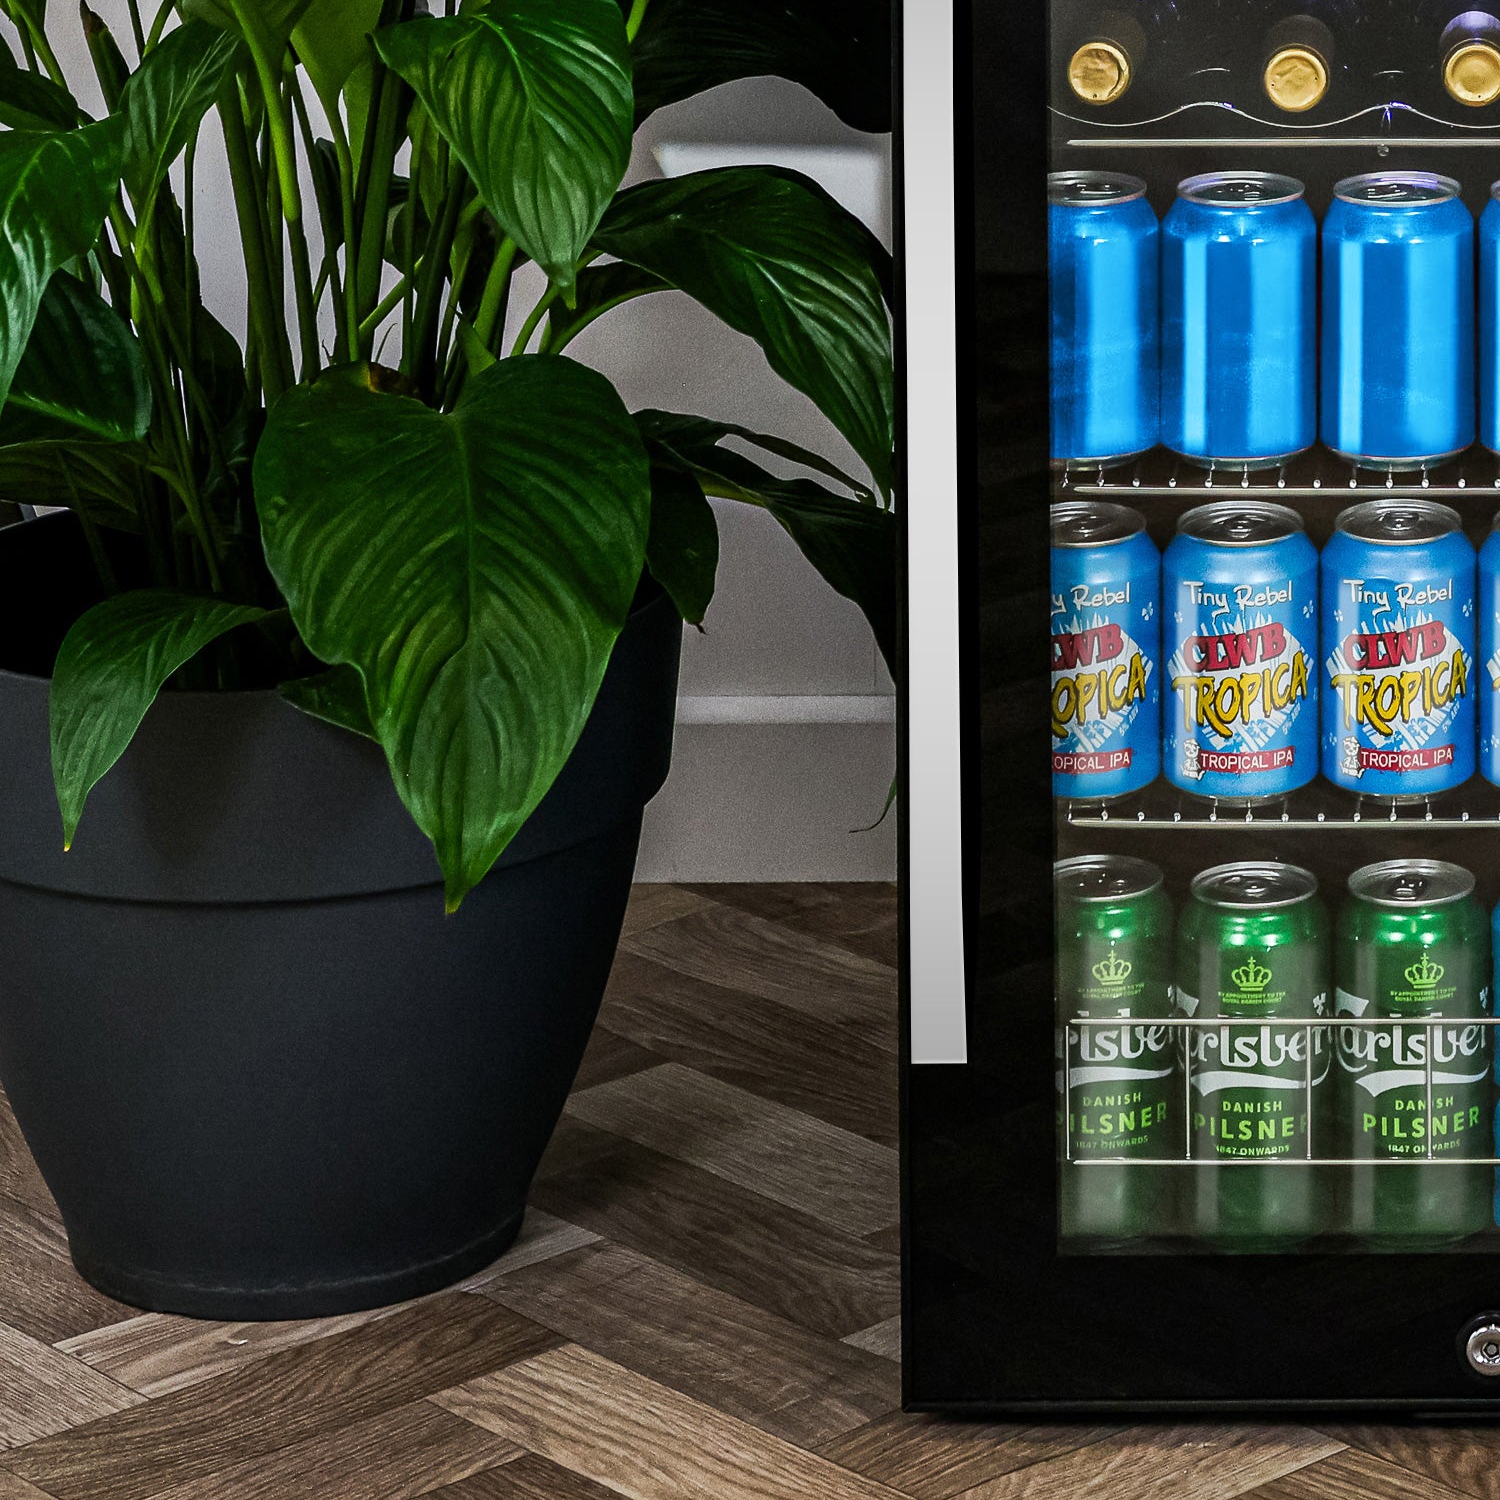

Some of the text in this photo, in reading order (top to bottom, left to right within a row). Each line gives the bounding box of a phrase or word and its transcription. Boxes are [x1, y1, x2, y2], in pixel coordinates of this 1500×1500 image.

[1070, 582, 1130, 611] Rebel
[1182, 580, 1293, 617] Tiny Rebel
[1343, 579, 1453, 617] Tiny Rebel
[1183, 622, 1287, 672] CLWB
[1343, 620, 1446, 670] CLWB
[1051, 653, 1145, 737] OPICA
[1172, 651, 1308, 738] TROPICA
[1331, 649, 1467, 737] TROPICA
[1053, 752, 1130, 770] OPICAL IPA
[1201, 750, 1293, 770] TROPICAL IPA
[1361, 748, 1453, 767] TROPICAL IPA
[1083, 1092, 1142, 1106] DANISH
[1222, 1100, 1282, 1113] DANISH
[1395, 1096, 1454, 1111] DANSH
[1057, 1102, 1167, 1135] ILSNER
[1363, 1106, 1479, 1138] PILSNER
